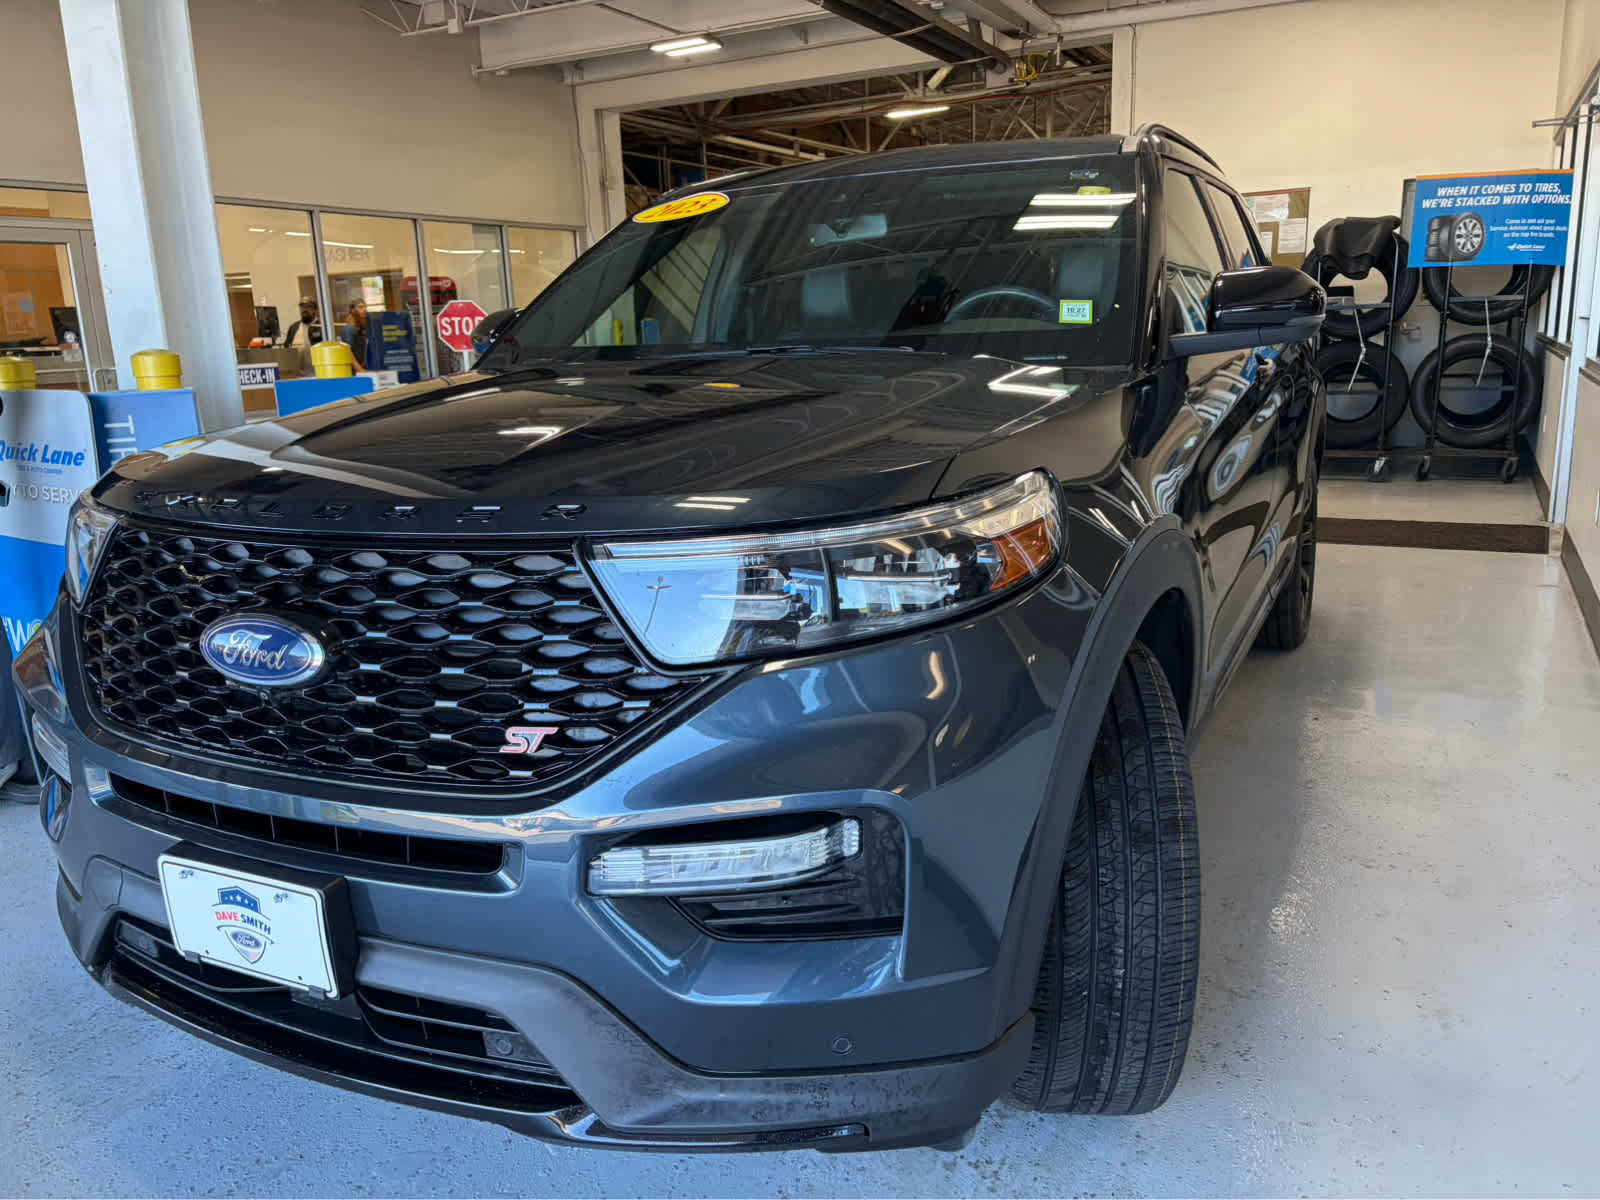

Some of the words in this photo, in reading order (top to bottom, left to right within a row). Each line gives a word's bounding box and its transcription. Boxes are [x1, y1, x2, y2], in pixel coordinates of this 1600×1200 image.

[1437, 186, 1467, 197] WHEN
[1469, 185, 1480, 196] IT
[1482, 184, 1516, 195] COMES
[1519, 183, 1532, 193] TO
[1535, 183, 1561, 194] TIRES,
[1422, 198, 1453, 209] WE'RE
[1455, 196, 1500, 207] STACKED
[1503, 195, 1529, 205] WITH
[1531, 194, 1572, 204] OPTIONS.
[240, 368, 276, 385] HECK-IN
[103, 414, 138, 464] TIR
[41, 444, 85, 467] Lane
[42, 485, 82, 505] SERV
[222, 629, 289, 670] Ford
[499, 726, 559, 753] ST
[214, 911, 239, 923] DAVE
[241, 914, 271, 935] SMITH
[236, 934, 257, 946] Ford
